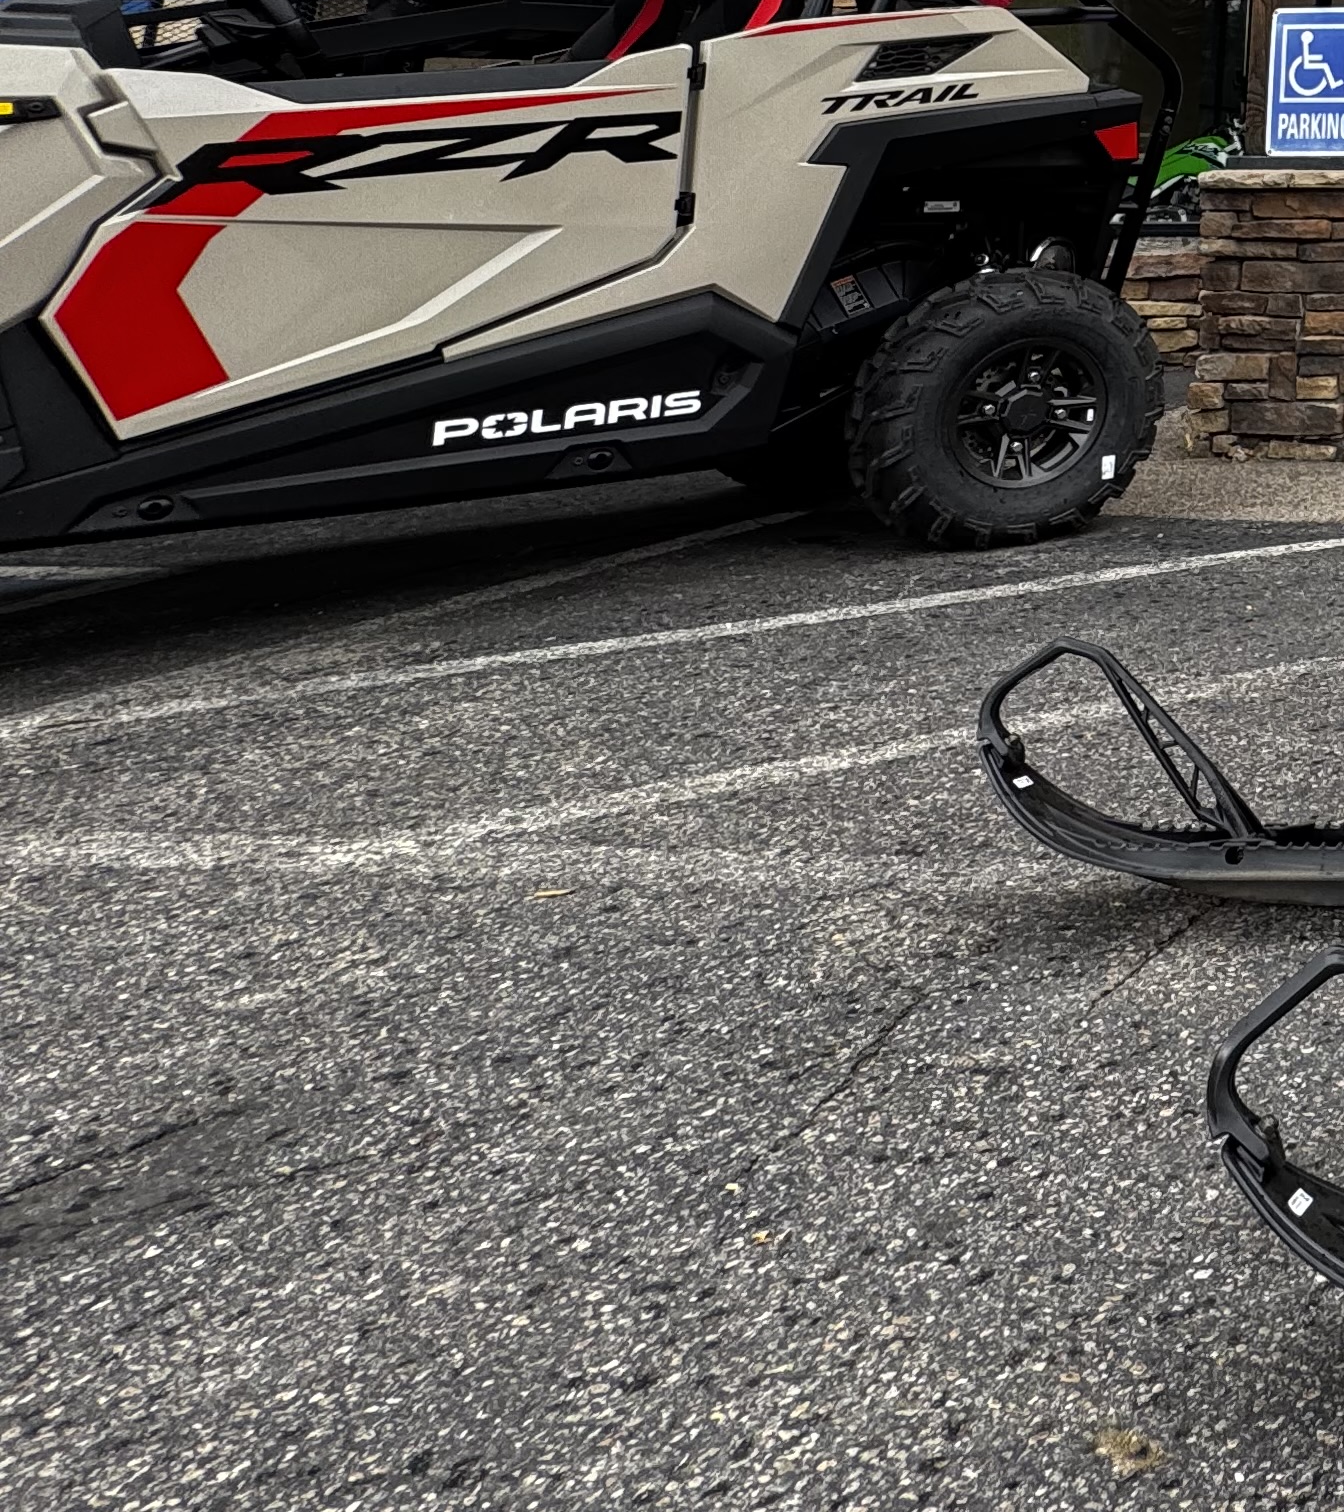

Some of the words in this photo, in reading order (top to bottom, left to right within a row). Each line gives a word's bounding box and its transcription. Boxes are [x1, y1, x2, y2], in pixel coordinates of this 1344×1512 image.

[821, 83, 979, 115] TRAIL
[145, 111, 682, 204] RZR
[432, 389, 703, 447] POLARIS
